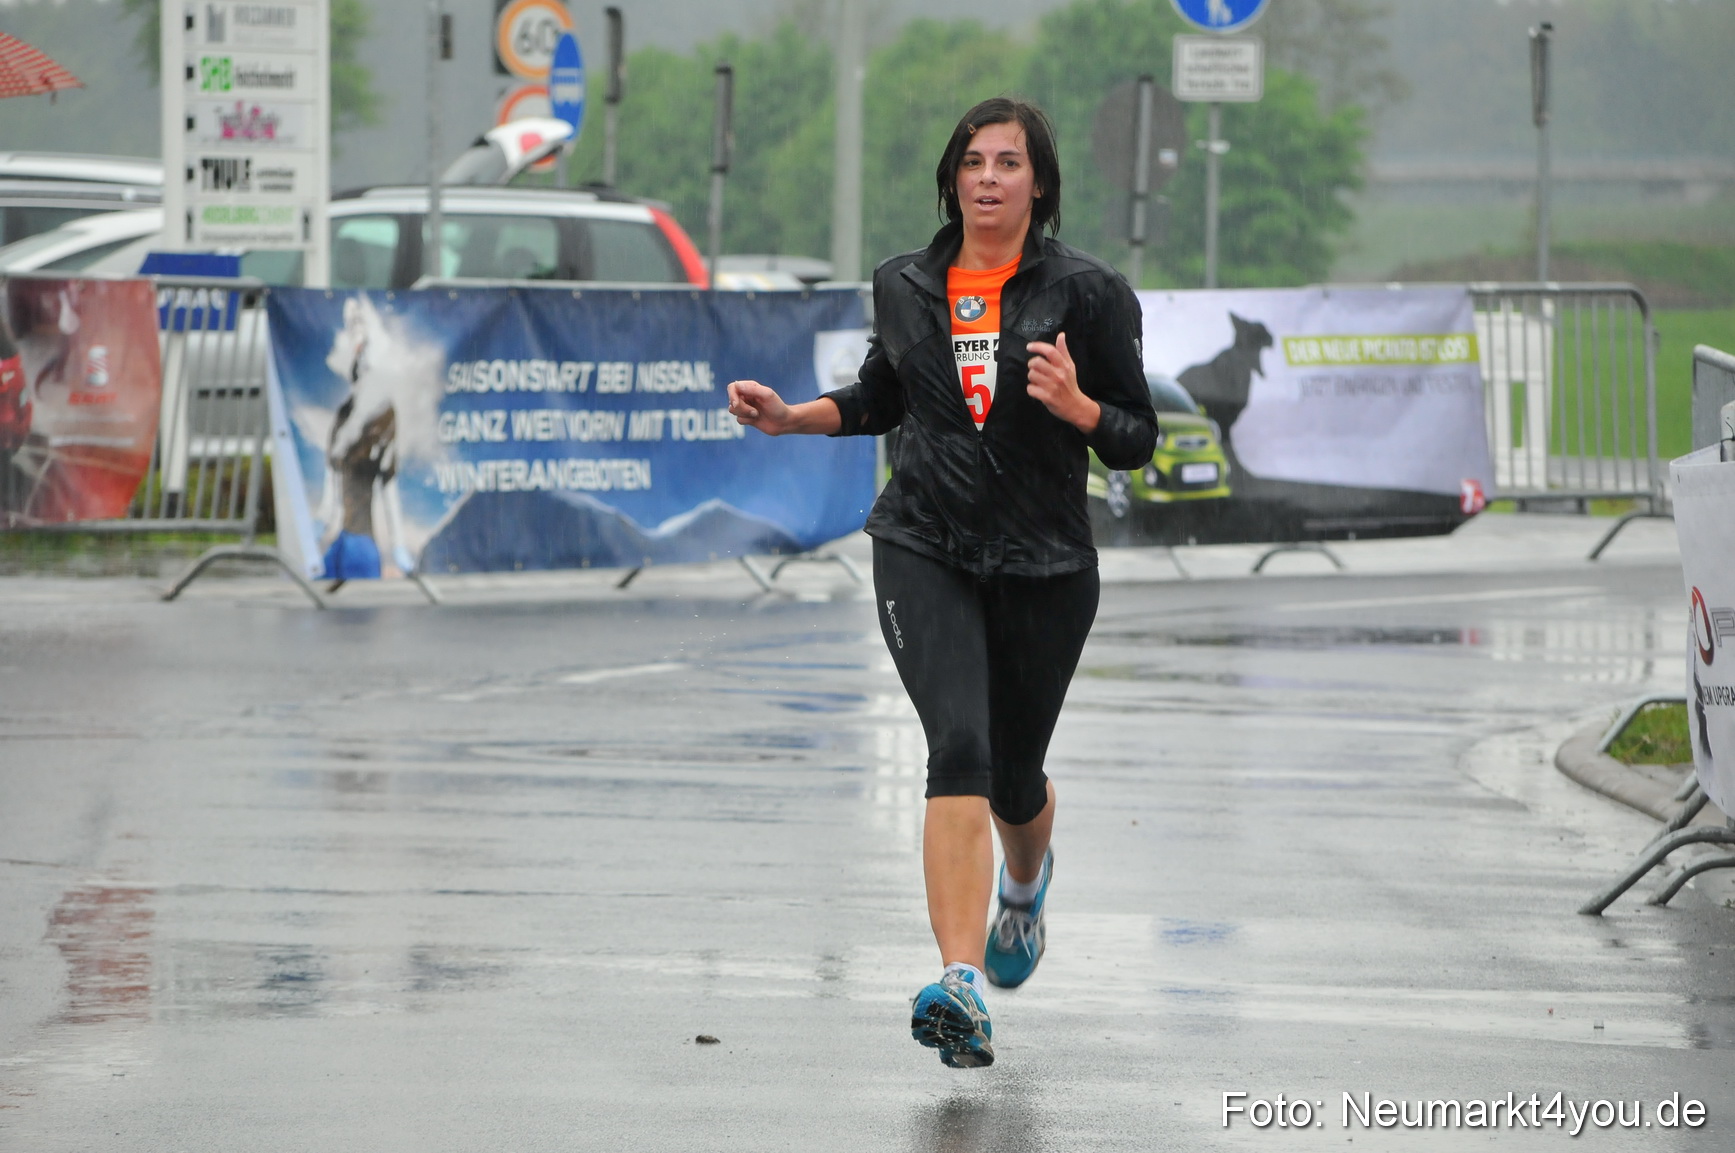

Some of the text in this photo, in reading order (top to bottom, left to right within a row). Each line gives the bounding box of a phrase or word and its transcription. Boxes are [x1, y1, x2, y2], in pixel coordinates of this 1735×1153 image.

[514, 18, 558, 56] 60
[958, 295, 985, 305] BMW
[954, 339, 989, 352] EYER
[955, 352, 990, 361] RBUNG
[1287, 338, 1322, 363] DER
[446, 359, 715, 394] SAISONSTART BEI NISSAN:
[961, 365, 992, 424] 5
[438, 410, 508, 443] GANZ
[627, 409, 665, 442] MIT
[667, 408, 746, 442] TOLLEN
[435, 458, 652, 493] WINTERANGEBOTEN
